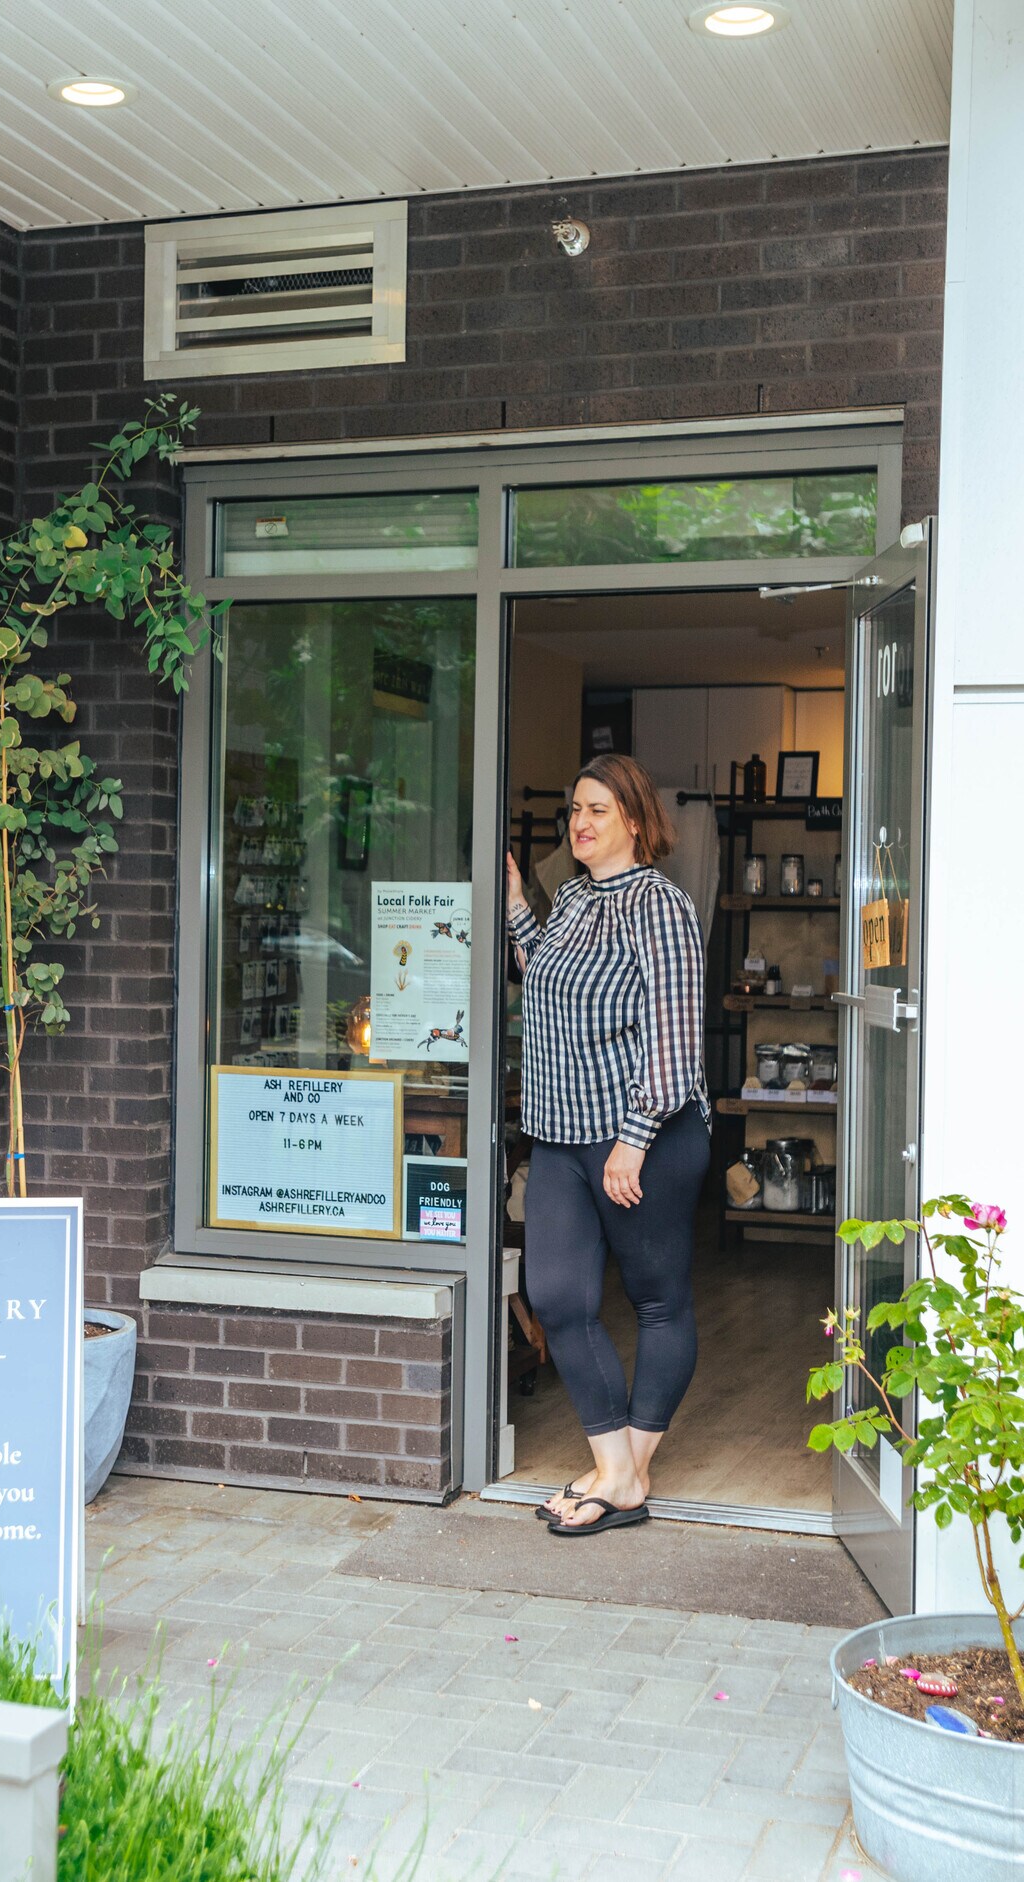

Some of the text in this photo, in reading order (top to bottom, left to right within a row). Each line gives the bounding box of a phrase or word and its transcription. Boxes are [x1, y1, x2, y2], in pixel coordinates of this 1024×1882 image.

[377, 895, 455, 907] Local Folk Fair
[863, 915, 886, 962] open
[264, 1079, 343, 1093] ASH REFILLERY
[283, 1092, 321, 1103] AND CO
[248, 1110, 364, 1127] OPEN 7 DAYS A WEEK
[283, 1138, 322, 1151] 11-6 PM
[430, 1181, 451, 1192] DOG
[221, 1184, 386, 1205] INSTAGRAM @ASHREFILLERYANDCO
[418, 1196, 463, 1208] FRIENDLY
[258, 1201, 346, 1217] ASHREFILLERY.CA
[431, 1217, 444, 1227] love
